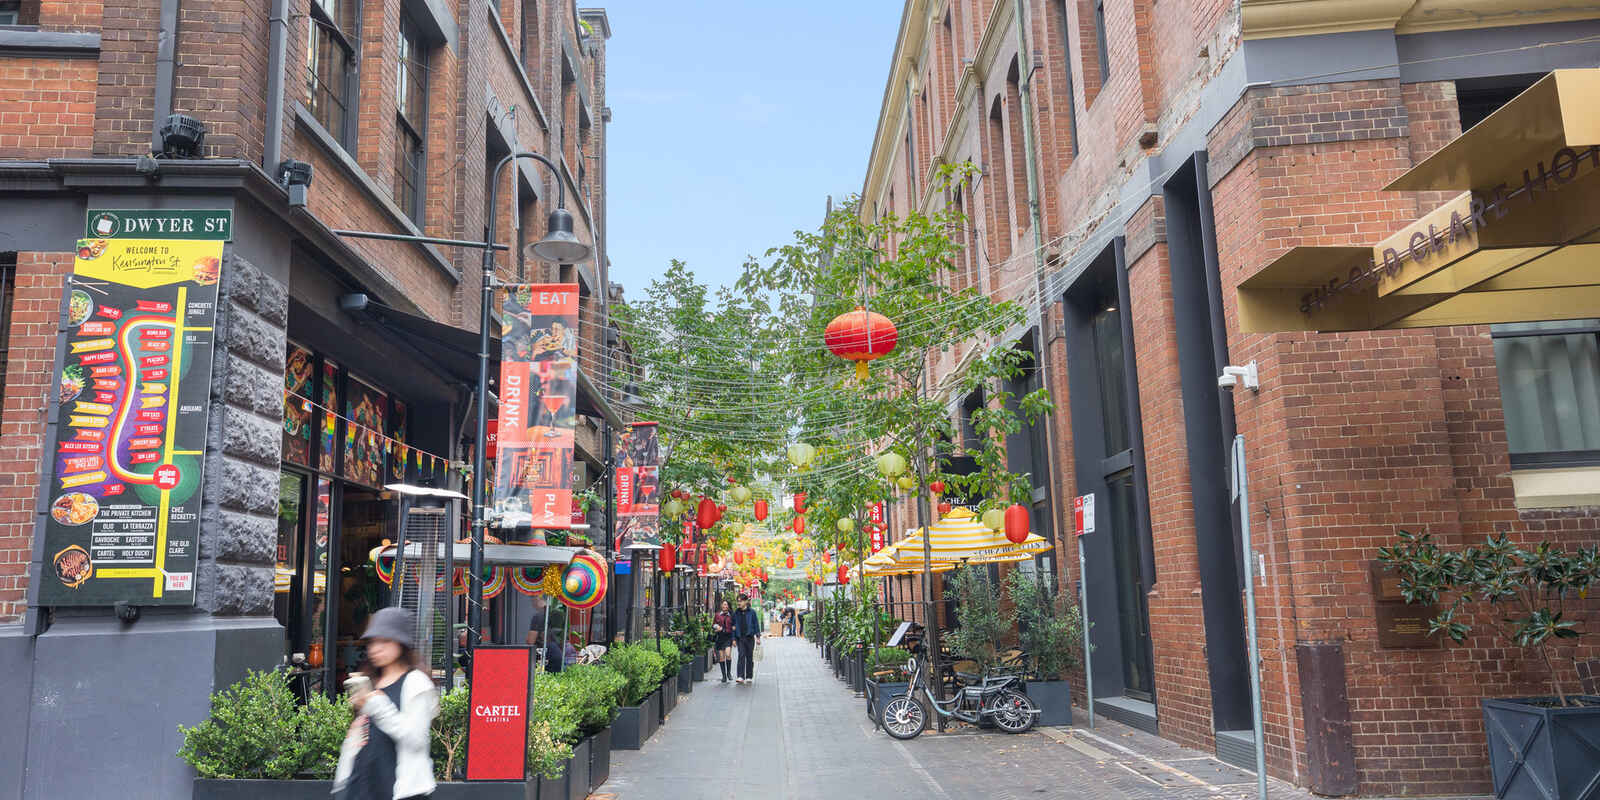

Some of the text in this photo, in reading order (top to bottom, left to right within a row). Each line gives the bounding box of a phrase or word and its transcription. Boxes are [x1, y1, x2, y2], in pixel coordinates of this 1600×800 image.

[124, 217, 228, 232] DWYER ST
[1300, 277, 1339, 318] THE
[1348, 247, 1400, 288] OLD
[1408, 184, 1510, 263] CLARE
[112, 255, 166, 272] Kensington
[540, 292, 569, 305] EAT
[504, 375, 521, 428] DRINK
[621, 475, 629, 504] DRINK
[543, 493, 556, 526] PLAY
[475, 705, 520, 717] CARTEL
